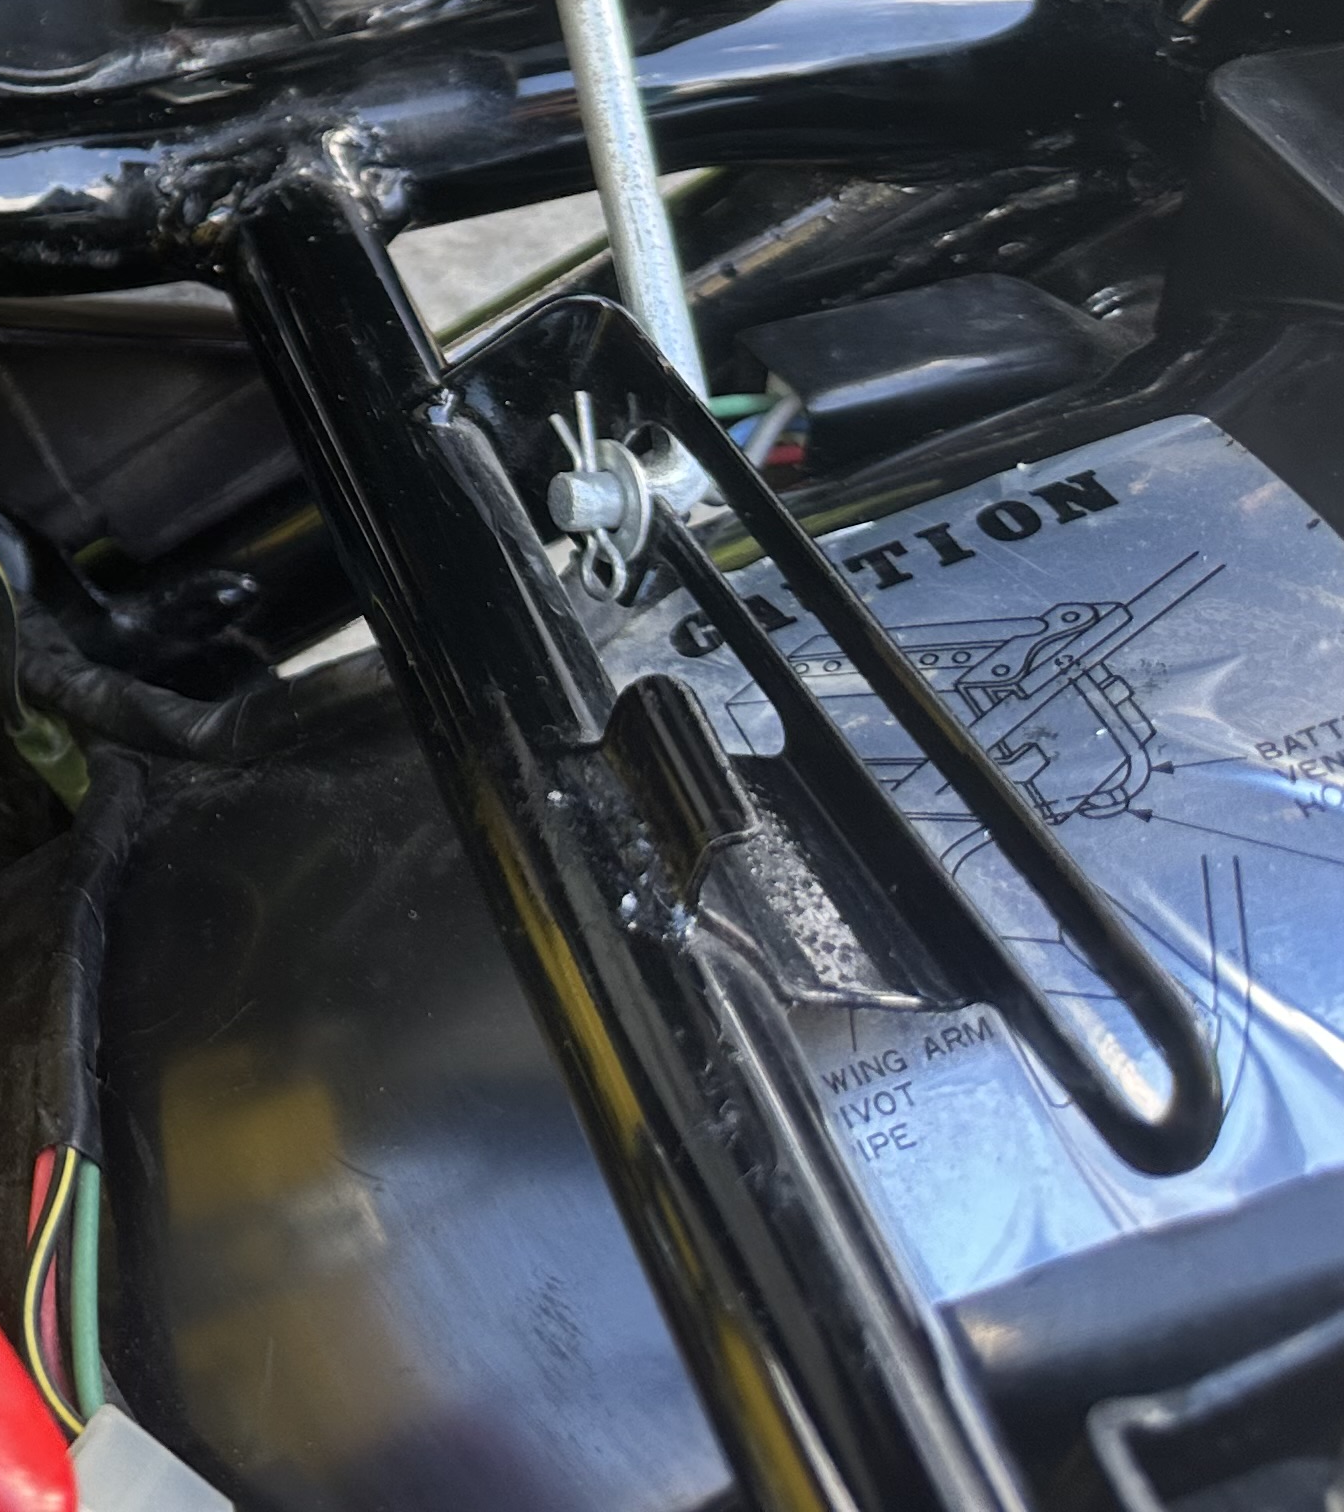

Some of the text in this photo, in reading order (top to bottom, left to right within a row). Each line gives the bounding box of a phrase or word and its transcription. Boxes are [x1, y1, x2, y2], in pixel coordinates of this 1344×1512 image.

[669, 469, 1120, 658] CTION
[1255, 715, 1344, 760] BATT
[1274, 750, 1344, 785] VEN
[821, 1016, 994, 1094] WING ARM
[838, 1080, 915, 1129] IVOT
[855, 1122, 918, 1163] IPE
